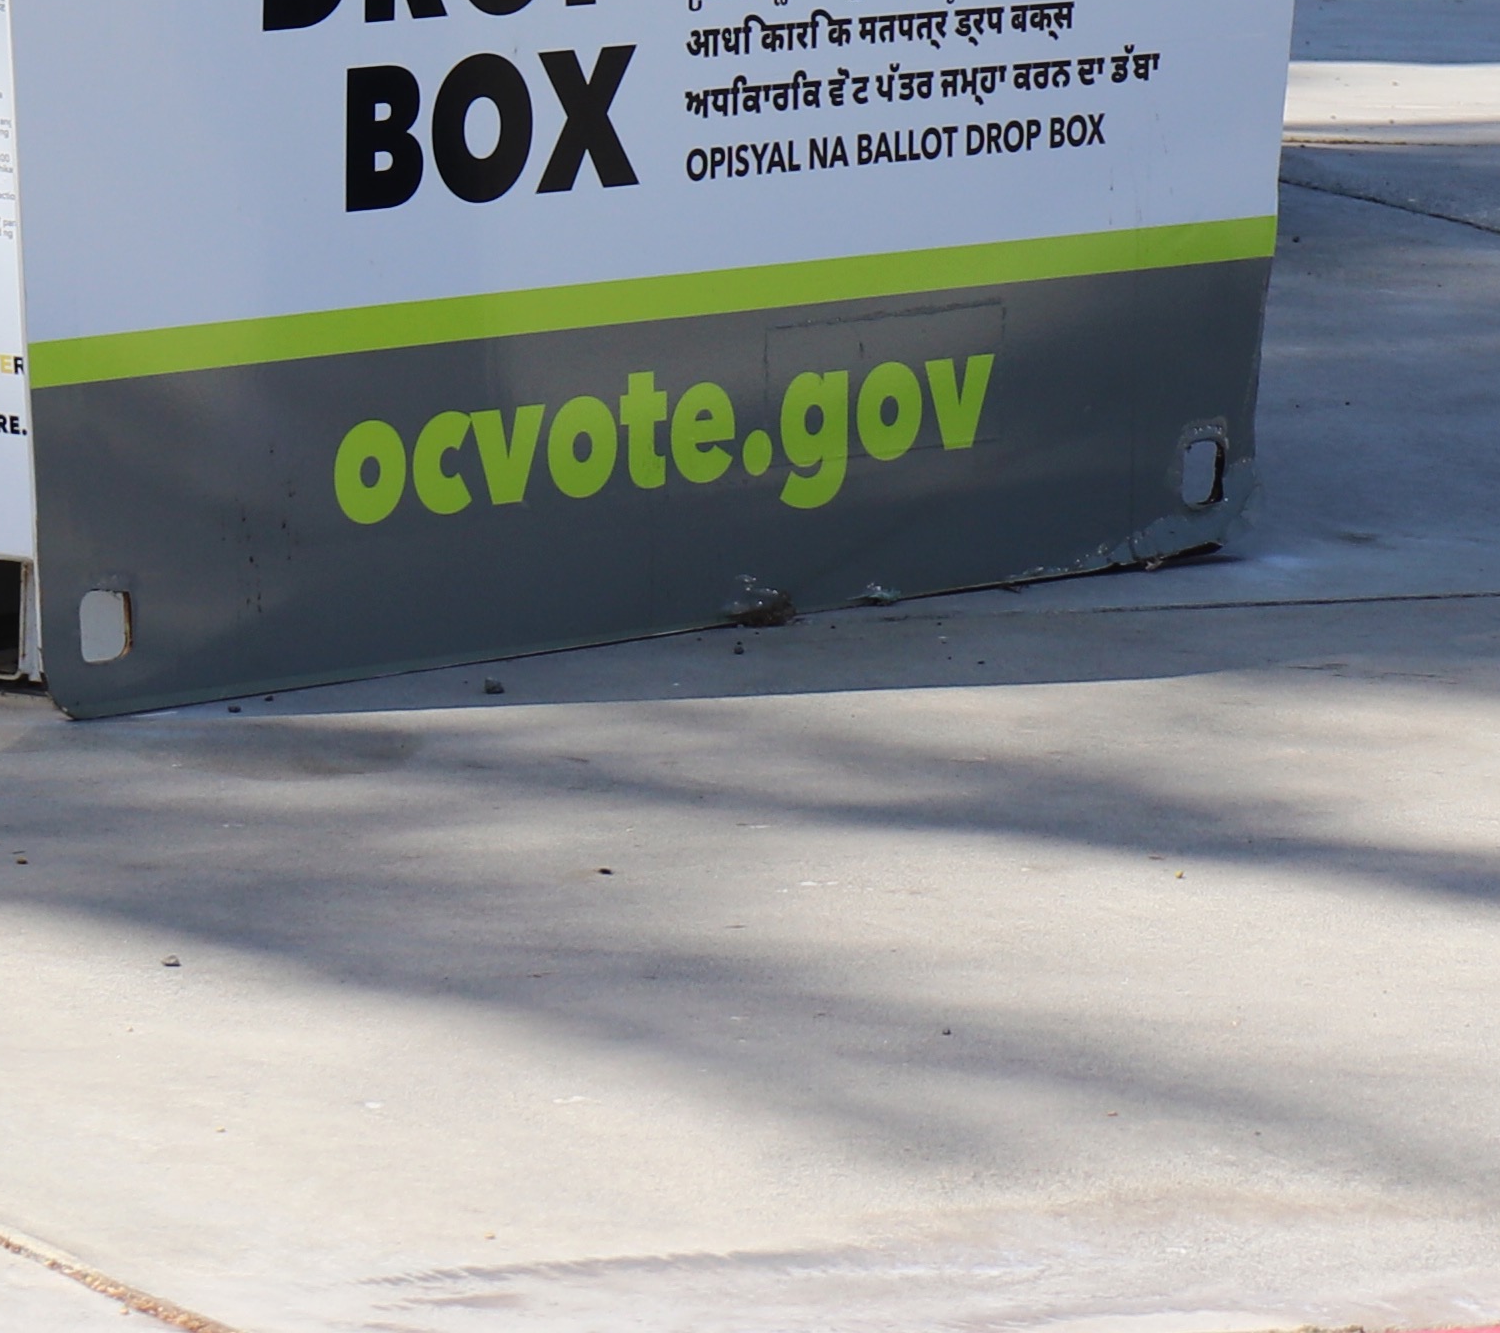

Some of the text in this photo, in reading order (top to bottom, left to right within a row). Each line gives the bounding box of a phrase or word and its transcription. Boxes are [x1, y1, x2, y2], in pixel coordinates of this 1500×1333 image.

[346, 45, 639, 212] BOX
[687, 113, 1105, 181] OPISYAL NA BALLOT DROP BOX
[333, 352, 996, 526] ocvote.gov
